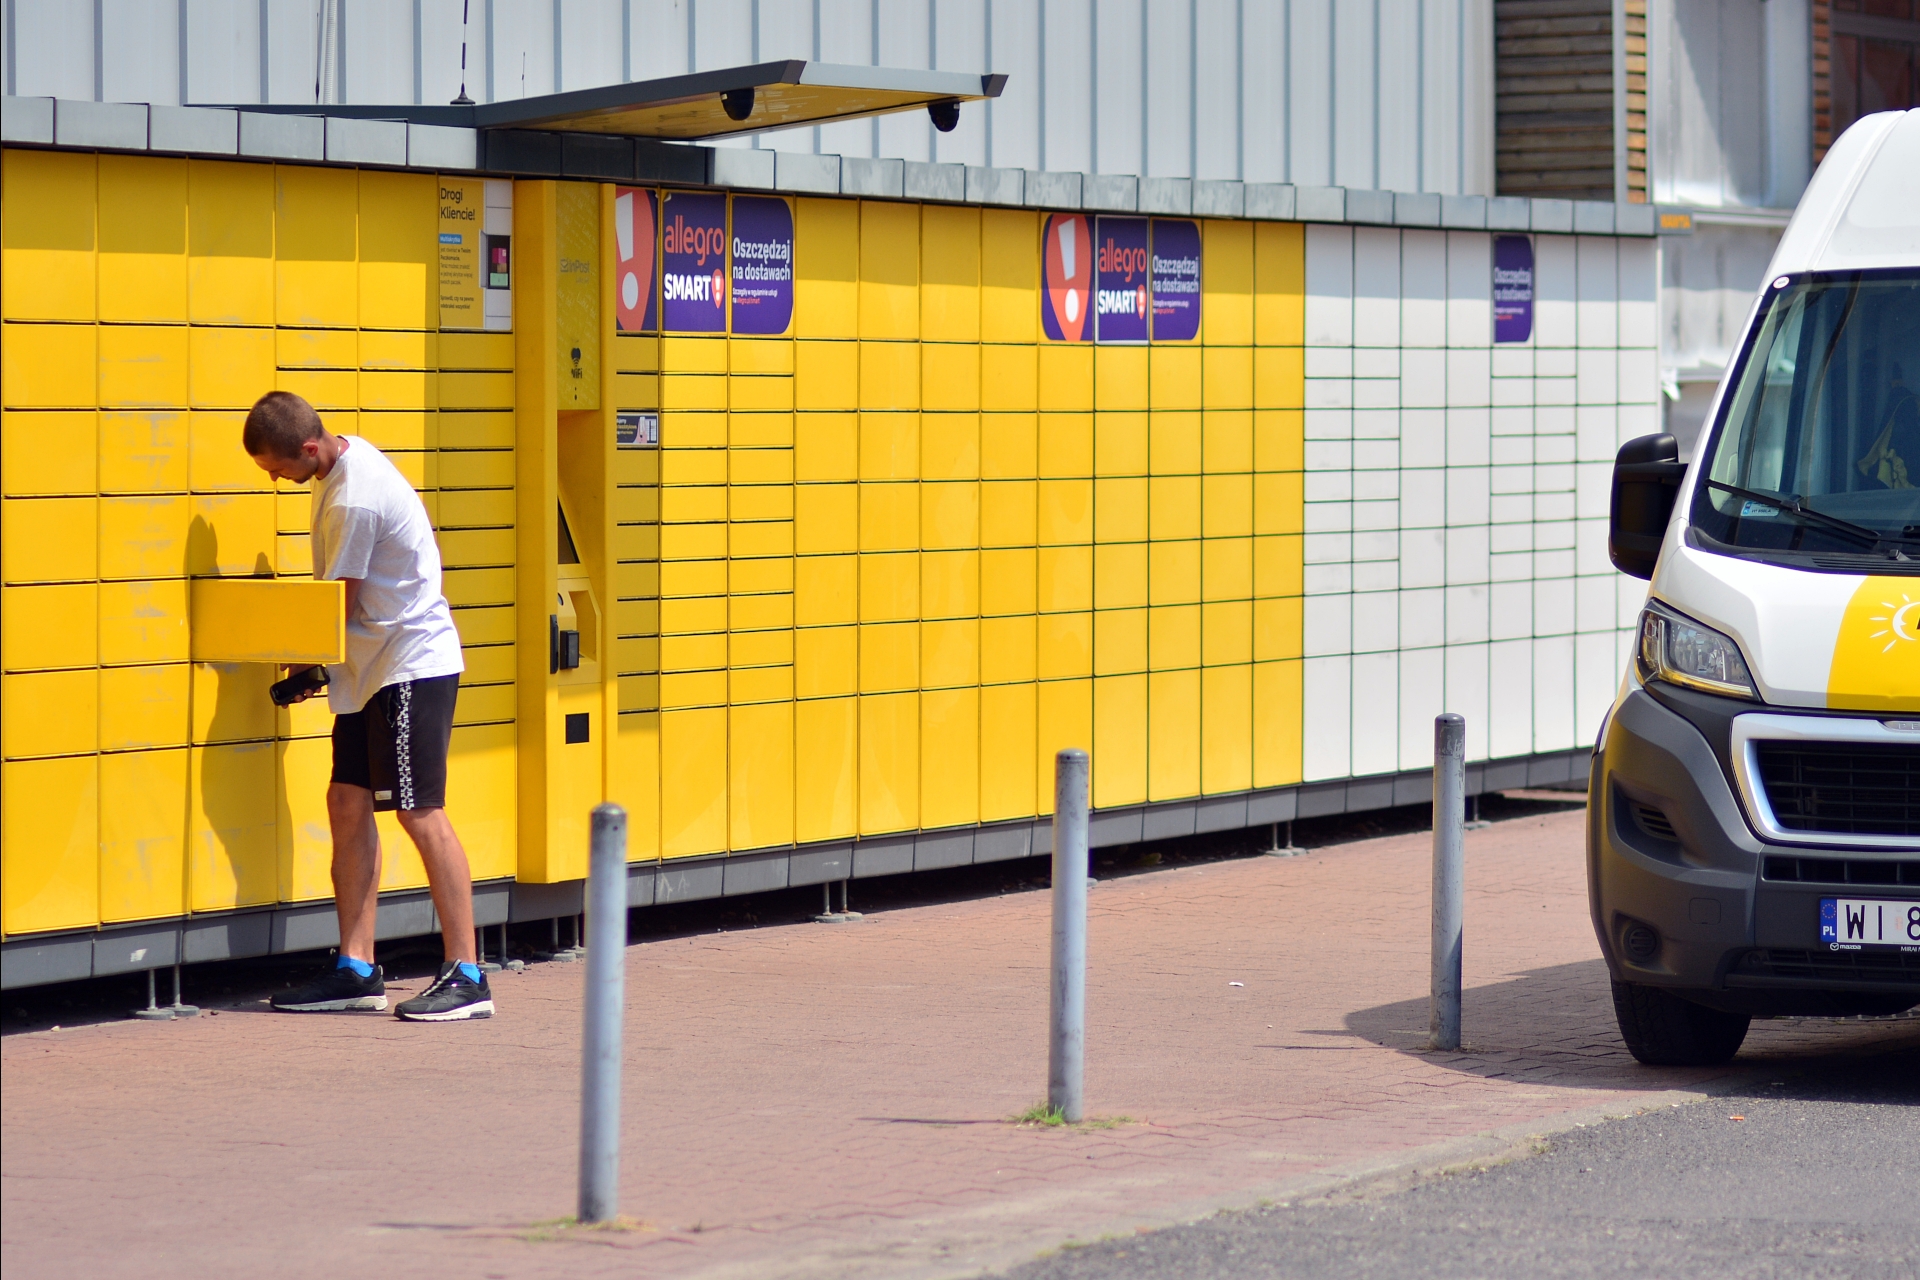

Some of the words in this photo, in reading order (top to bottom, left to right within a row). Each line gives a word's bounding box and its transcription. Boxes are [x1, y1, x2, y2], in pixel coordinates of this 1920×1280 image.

[441, 188, 463, 204] Drogi
[441, 206, 476, 221] Kliencie!
[664, 214, 725, 266] allegro
[732, 237, 791, 264] Oszczędzaj
[1098, 238, 1147, 283] allegro
[1152, 254, 1199, 279] Oszczędzaj
[732, 265, 744, 280] na
[744, 263, 791, 281] dostawach
[1152, 280, 1162, 292] na
[1162, 277, 1199, 293] dostawach
[1822, 925, 1836, 936] PL
[1845, 904, 1883, 941] WI
